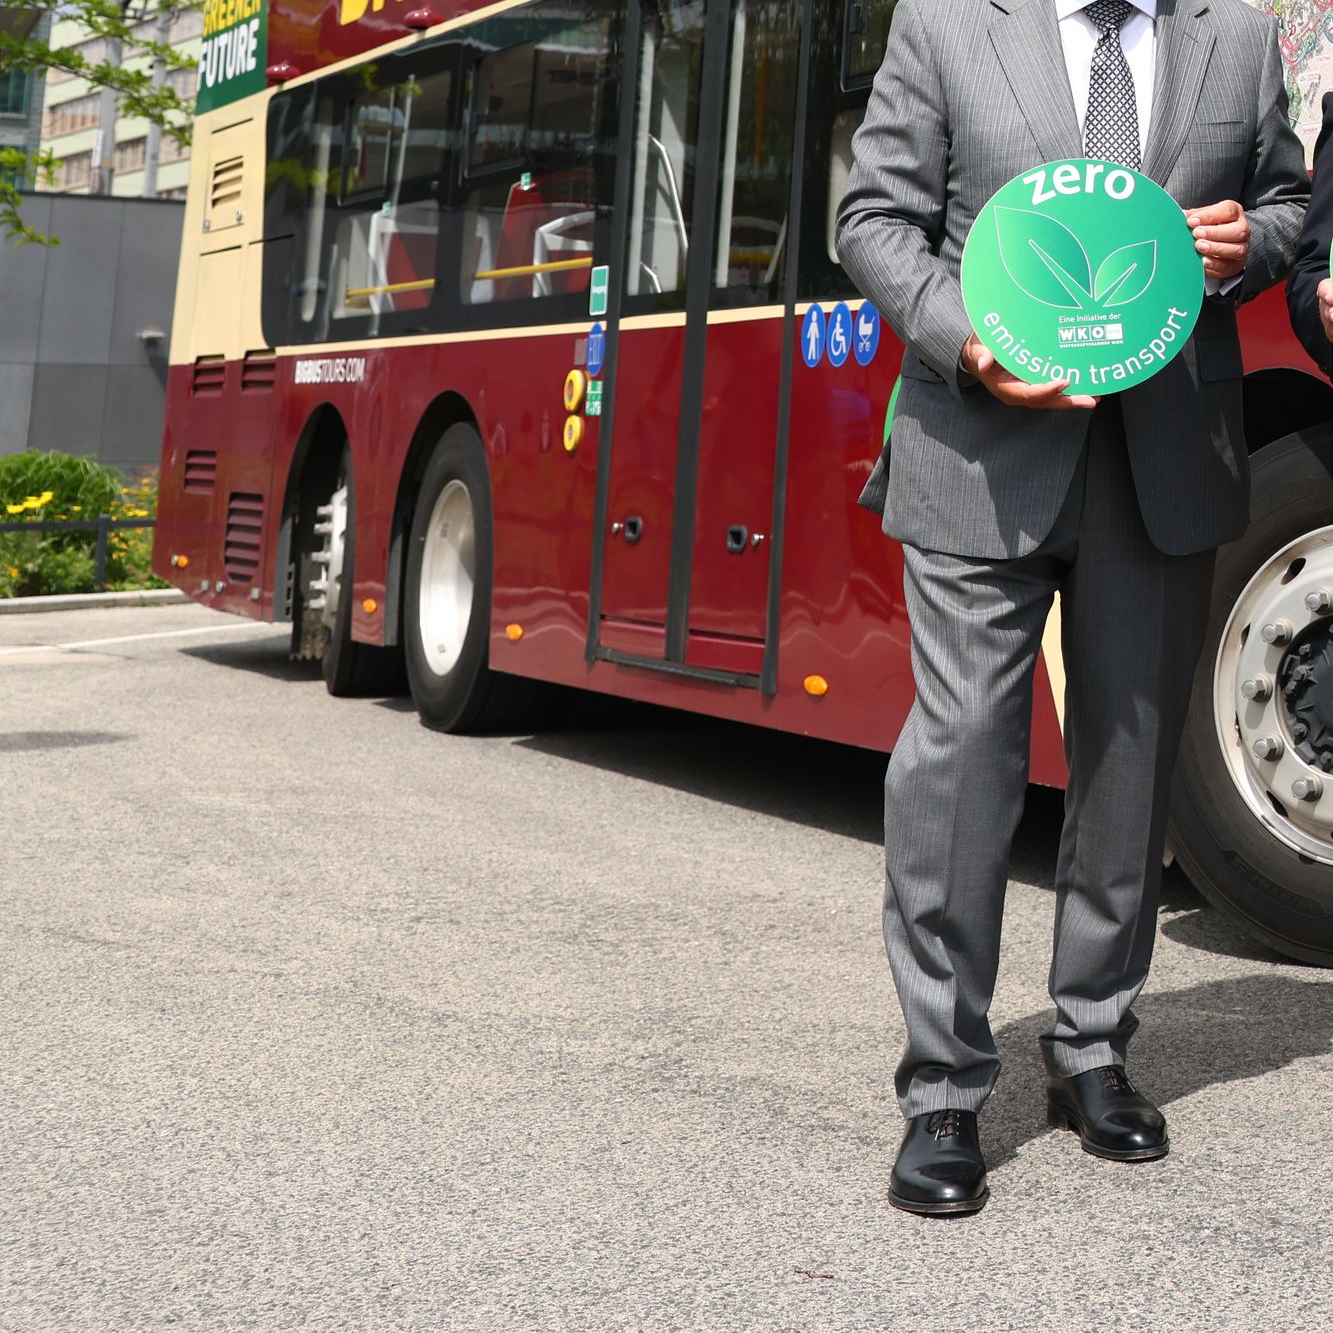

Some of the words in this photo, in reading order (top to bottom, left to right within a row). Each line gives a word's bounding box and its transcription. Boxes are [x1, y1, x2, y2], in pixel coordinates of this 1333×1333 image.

[196, 18, 260, 92] FUTURE
[1023, 163, 1136, 206] zero
[1058, 315, 1075, 323] Eine
[1076, 313, 1107, 322] Initiative
[1108, 312, 1121, 320] der
[1059, 326, 1105, 341] WKO
[984, 312, 1080, 385] emission
[1089, 306, 1188, 385] transport
